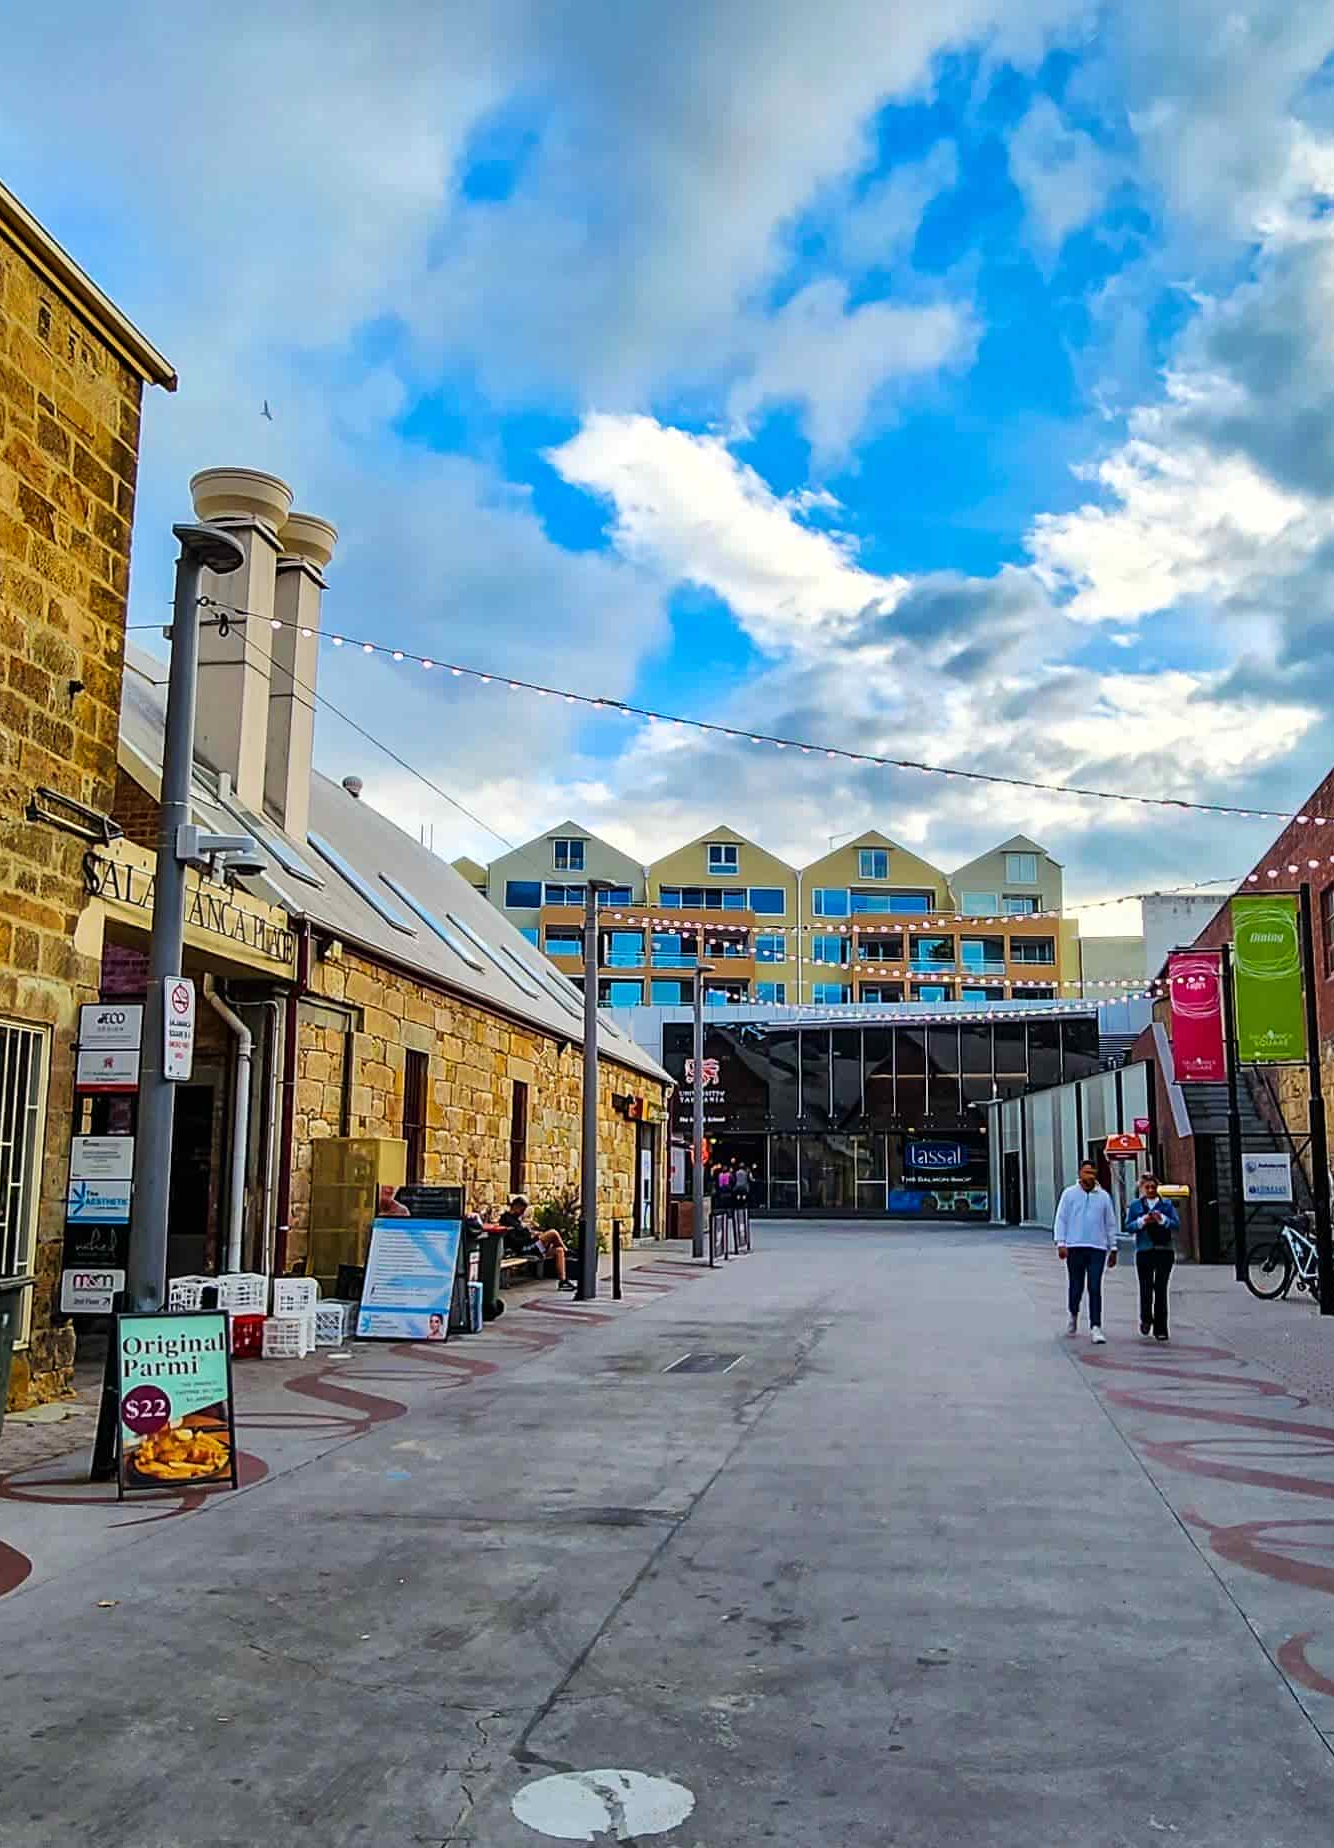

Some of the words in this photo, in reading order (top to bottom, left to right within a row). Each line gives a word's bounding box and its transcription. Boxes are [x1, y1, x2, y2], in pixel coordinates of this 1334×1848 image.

[84, 851, 245, 943] SALAANCA
[122, 1331, 225, 1358] Original
[123, 1355, 198, 1378] Parmi
[125, 1398, 167, 1420] $22
